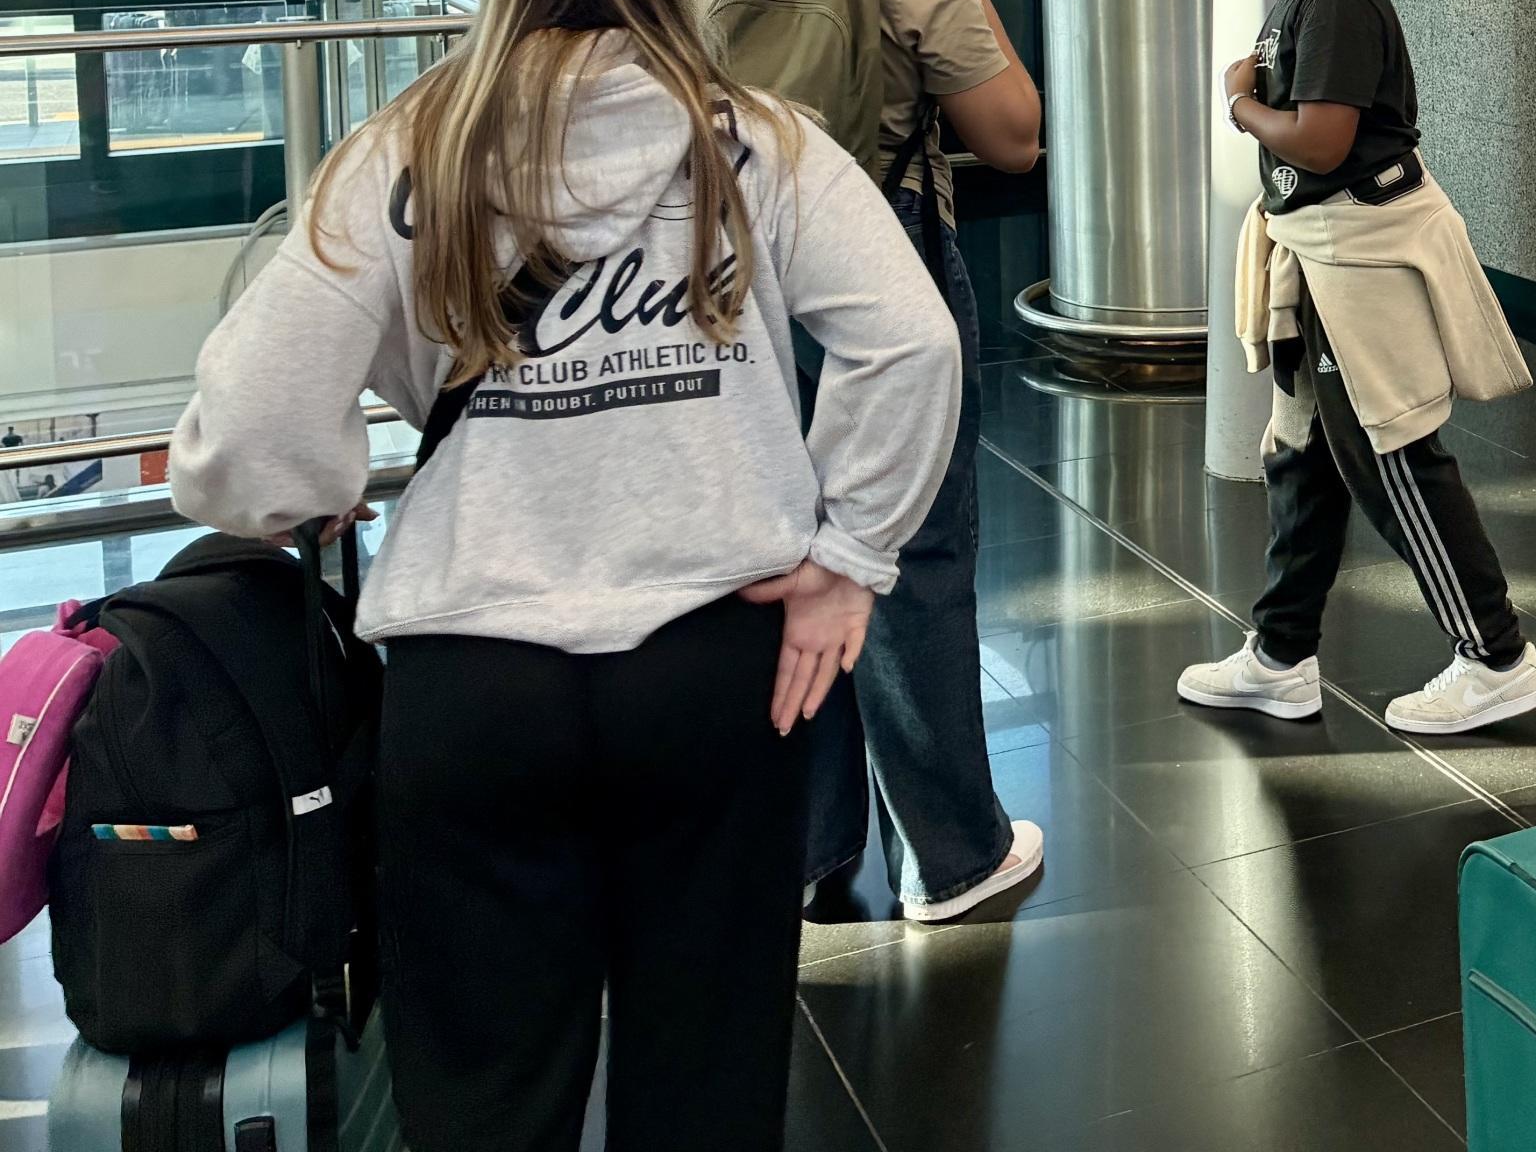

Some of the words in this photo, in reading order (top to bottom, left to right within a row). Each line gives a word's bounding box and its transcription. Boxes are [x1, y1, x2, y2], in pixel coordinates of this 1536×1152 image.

[519, 360, 588, 385] CLUB
[599, 344, 705, 377] ATHLETIC
[715, 342, 756, 364] CO.
[468, 397, 511, 410] HEN
[531, 394, 596, 412] DOUBT.
[604, 385, 646, 402] PUTT
[652, 382, 666, 396] IT
[675, 377, 704, 392] OUT
